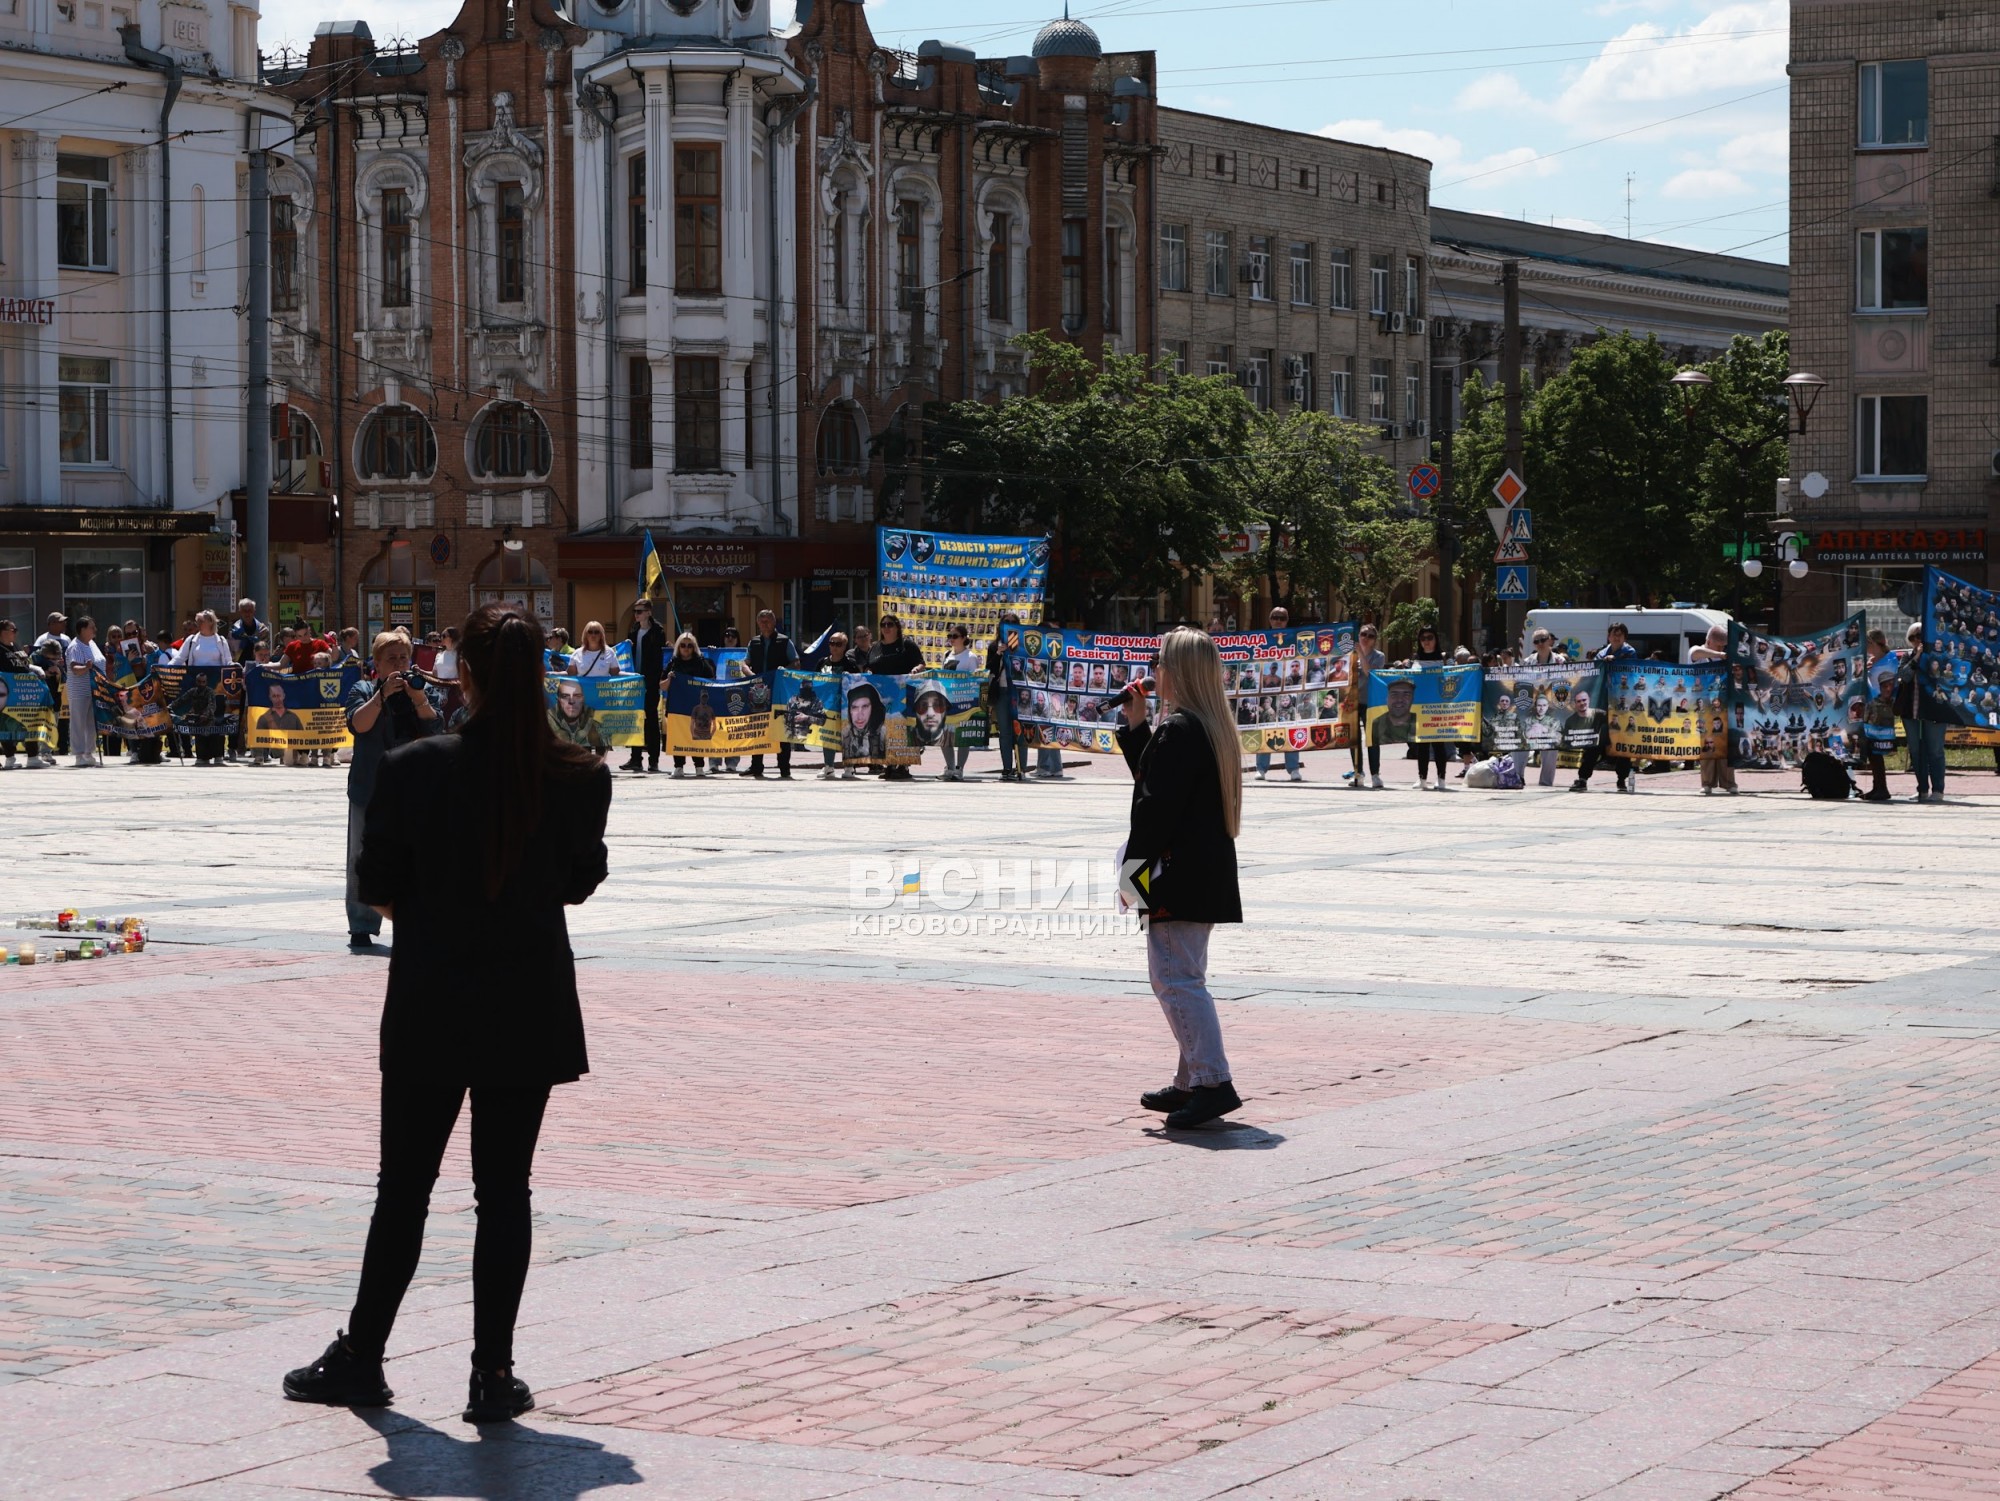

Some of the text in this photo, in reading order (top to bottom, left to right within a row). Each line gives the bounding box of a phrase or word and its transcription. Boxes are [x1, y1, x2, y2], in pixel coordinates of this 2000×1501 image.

[80, 516, 178, 530] МОДНИЙ ЖІНОЧИЙ ОДЯГ
[1819, 530, 1930, 549] АПТЕКА
[939, 540, 986, 553] БЕЗВІСТИ
[934, 554, 946, 565] НЕ
[947, 555, 990, 568] ЗНАЧИТЬ
[1818, 552, 1984, 560] ГОЛОВНА АПТЕКА ТВОГО МІСТА
[1094, 634, 1267, 648] НОВОУКРАЇ РОМАДА
[1066, 646, 1120, 660] Безвісти
[1254, 643, 1296, 660] Забуті
[1568, 662, 1594, 670] БРИГАДА
[749, 714, 770, 724] ДМИТРО
[726, 722, 770, 733] СТАНІСЛАВОВИЧ
[321, 736, 346, 745] ДОДОМУ!
[1654, 736, 1675, 744] ОШБр
[1616, 743, 1700, 756] ОБ'ЄДНАНІ НАДІЄЮ
